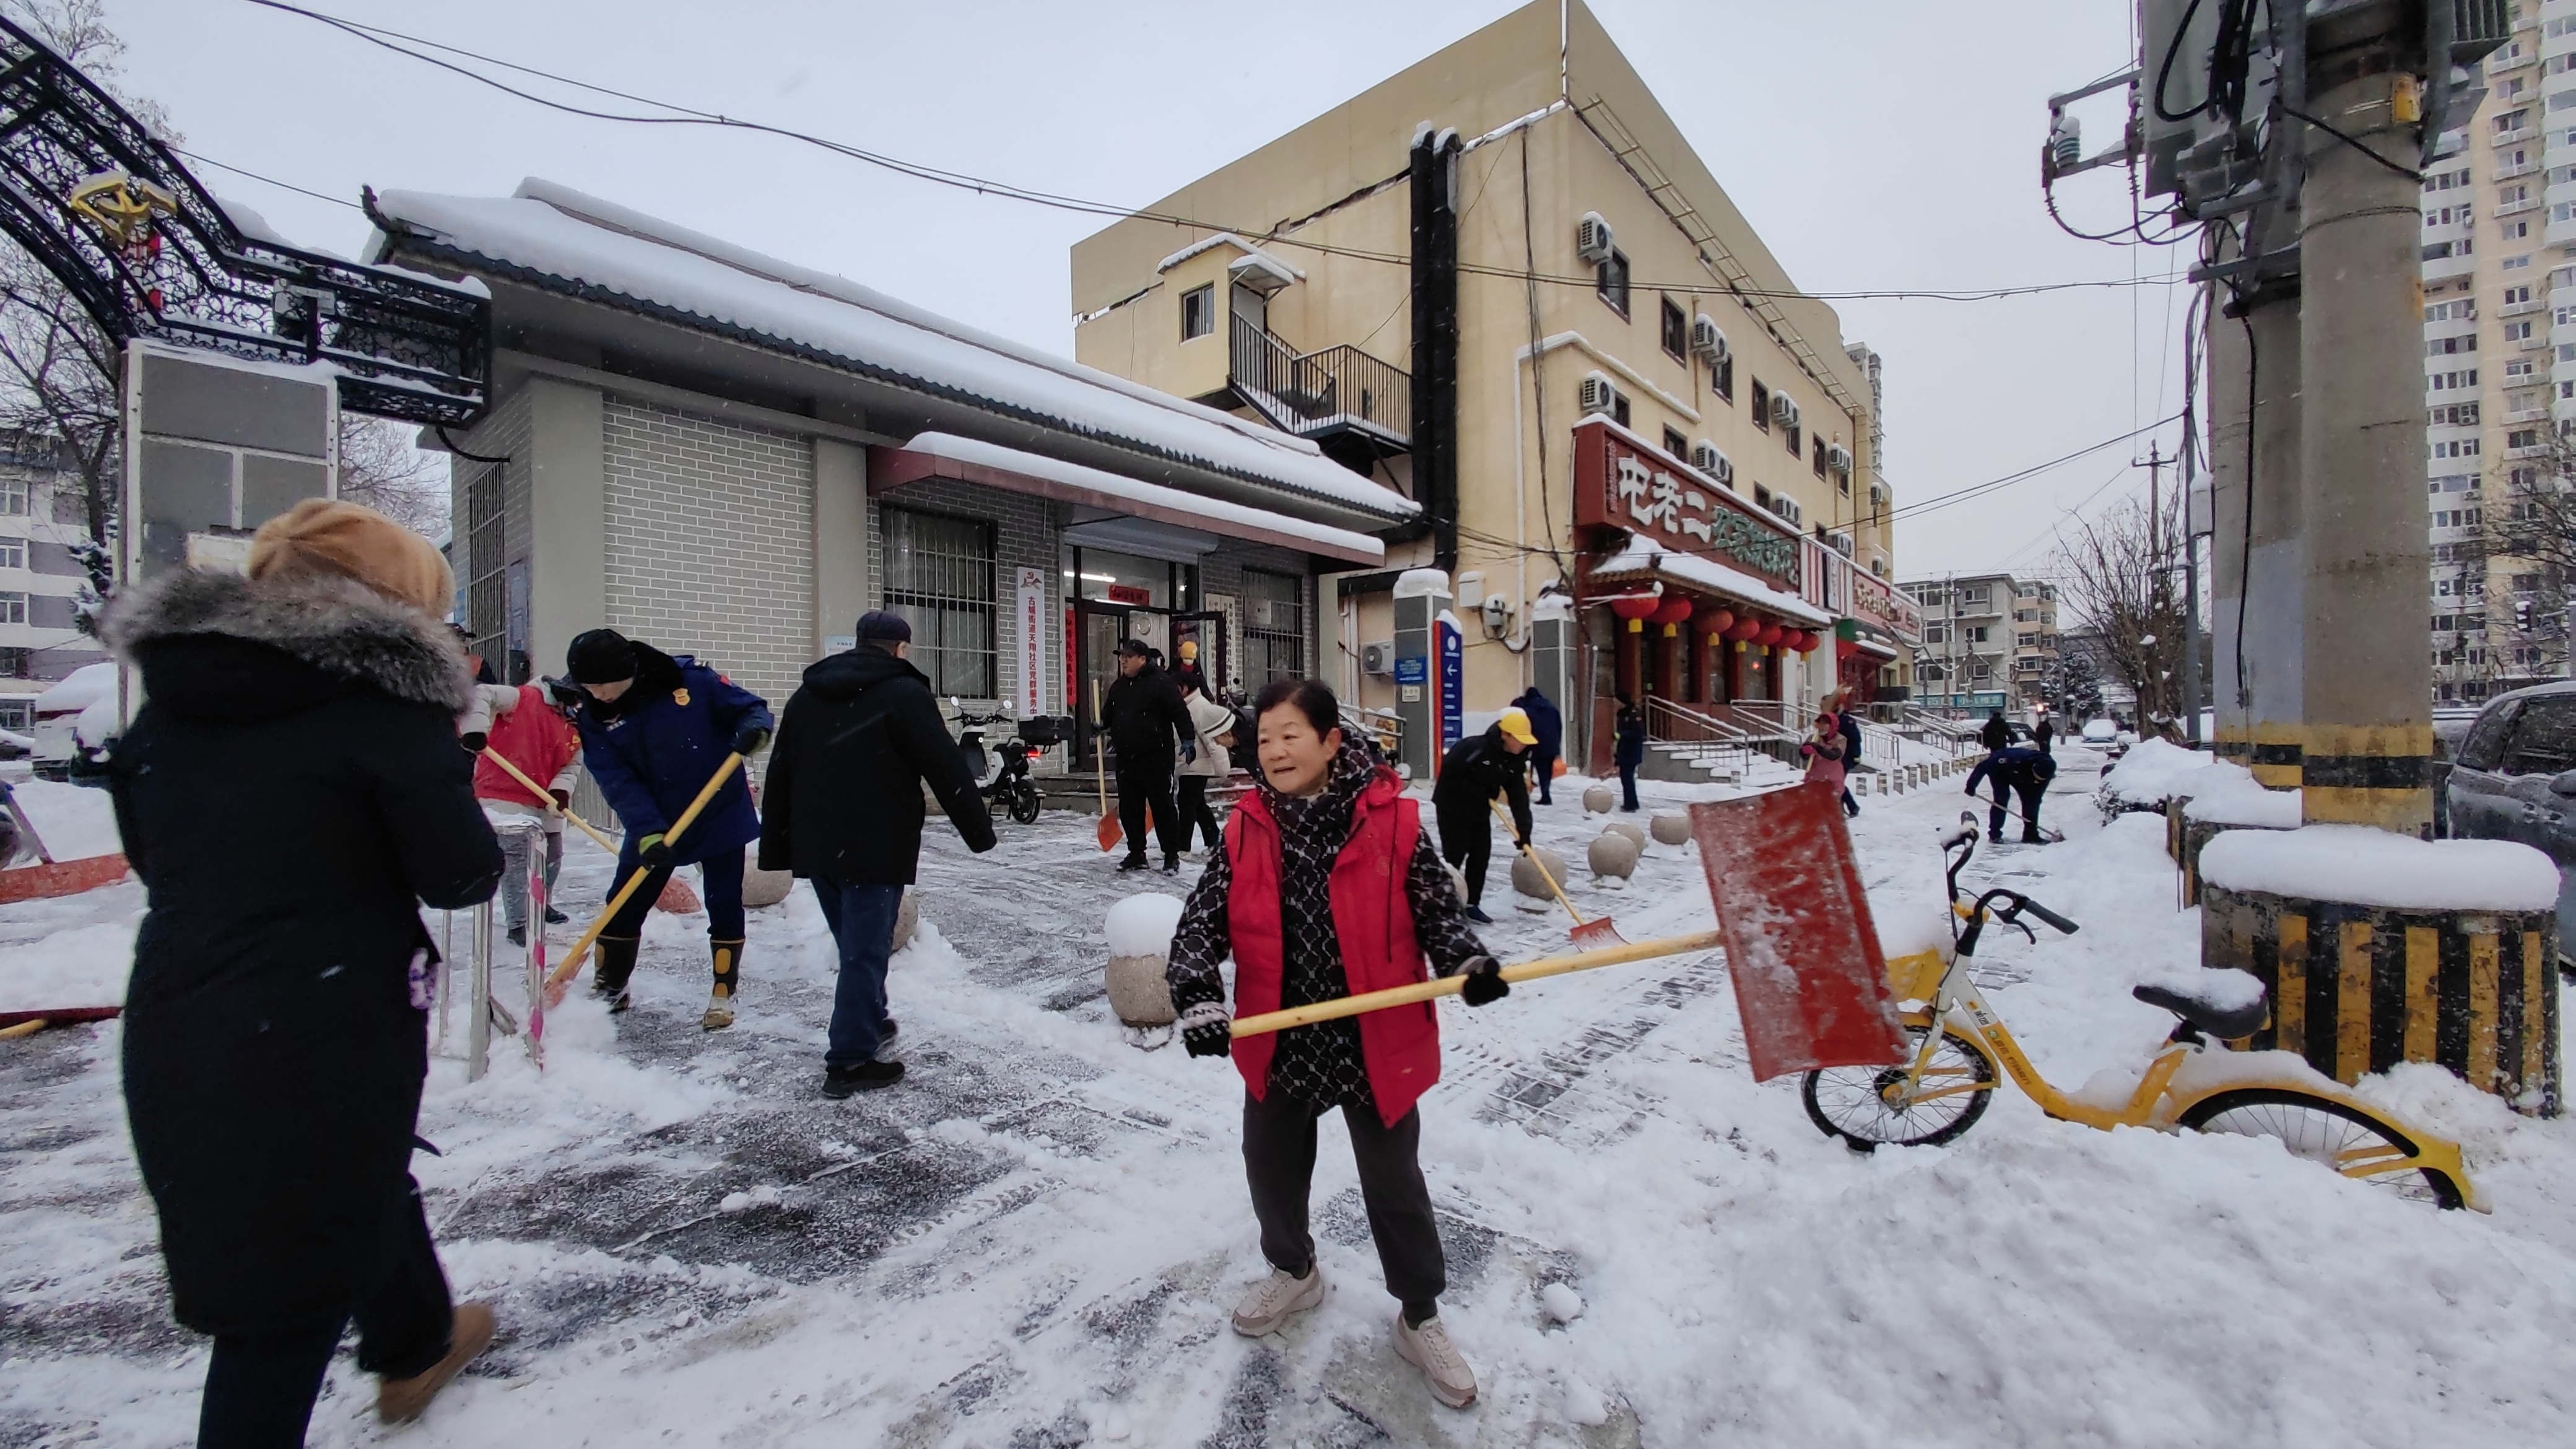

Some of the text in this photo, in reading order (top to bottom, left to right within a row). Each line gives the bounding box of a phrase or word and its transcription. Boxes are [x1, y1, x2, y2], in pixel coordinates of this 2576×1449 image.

[1618, 454, 1711, 542] 屯老二
[1975, 1011, 1989, 1025] 美团
